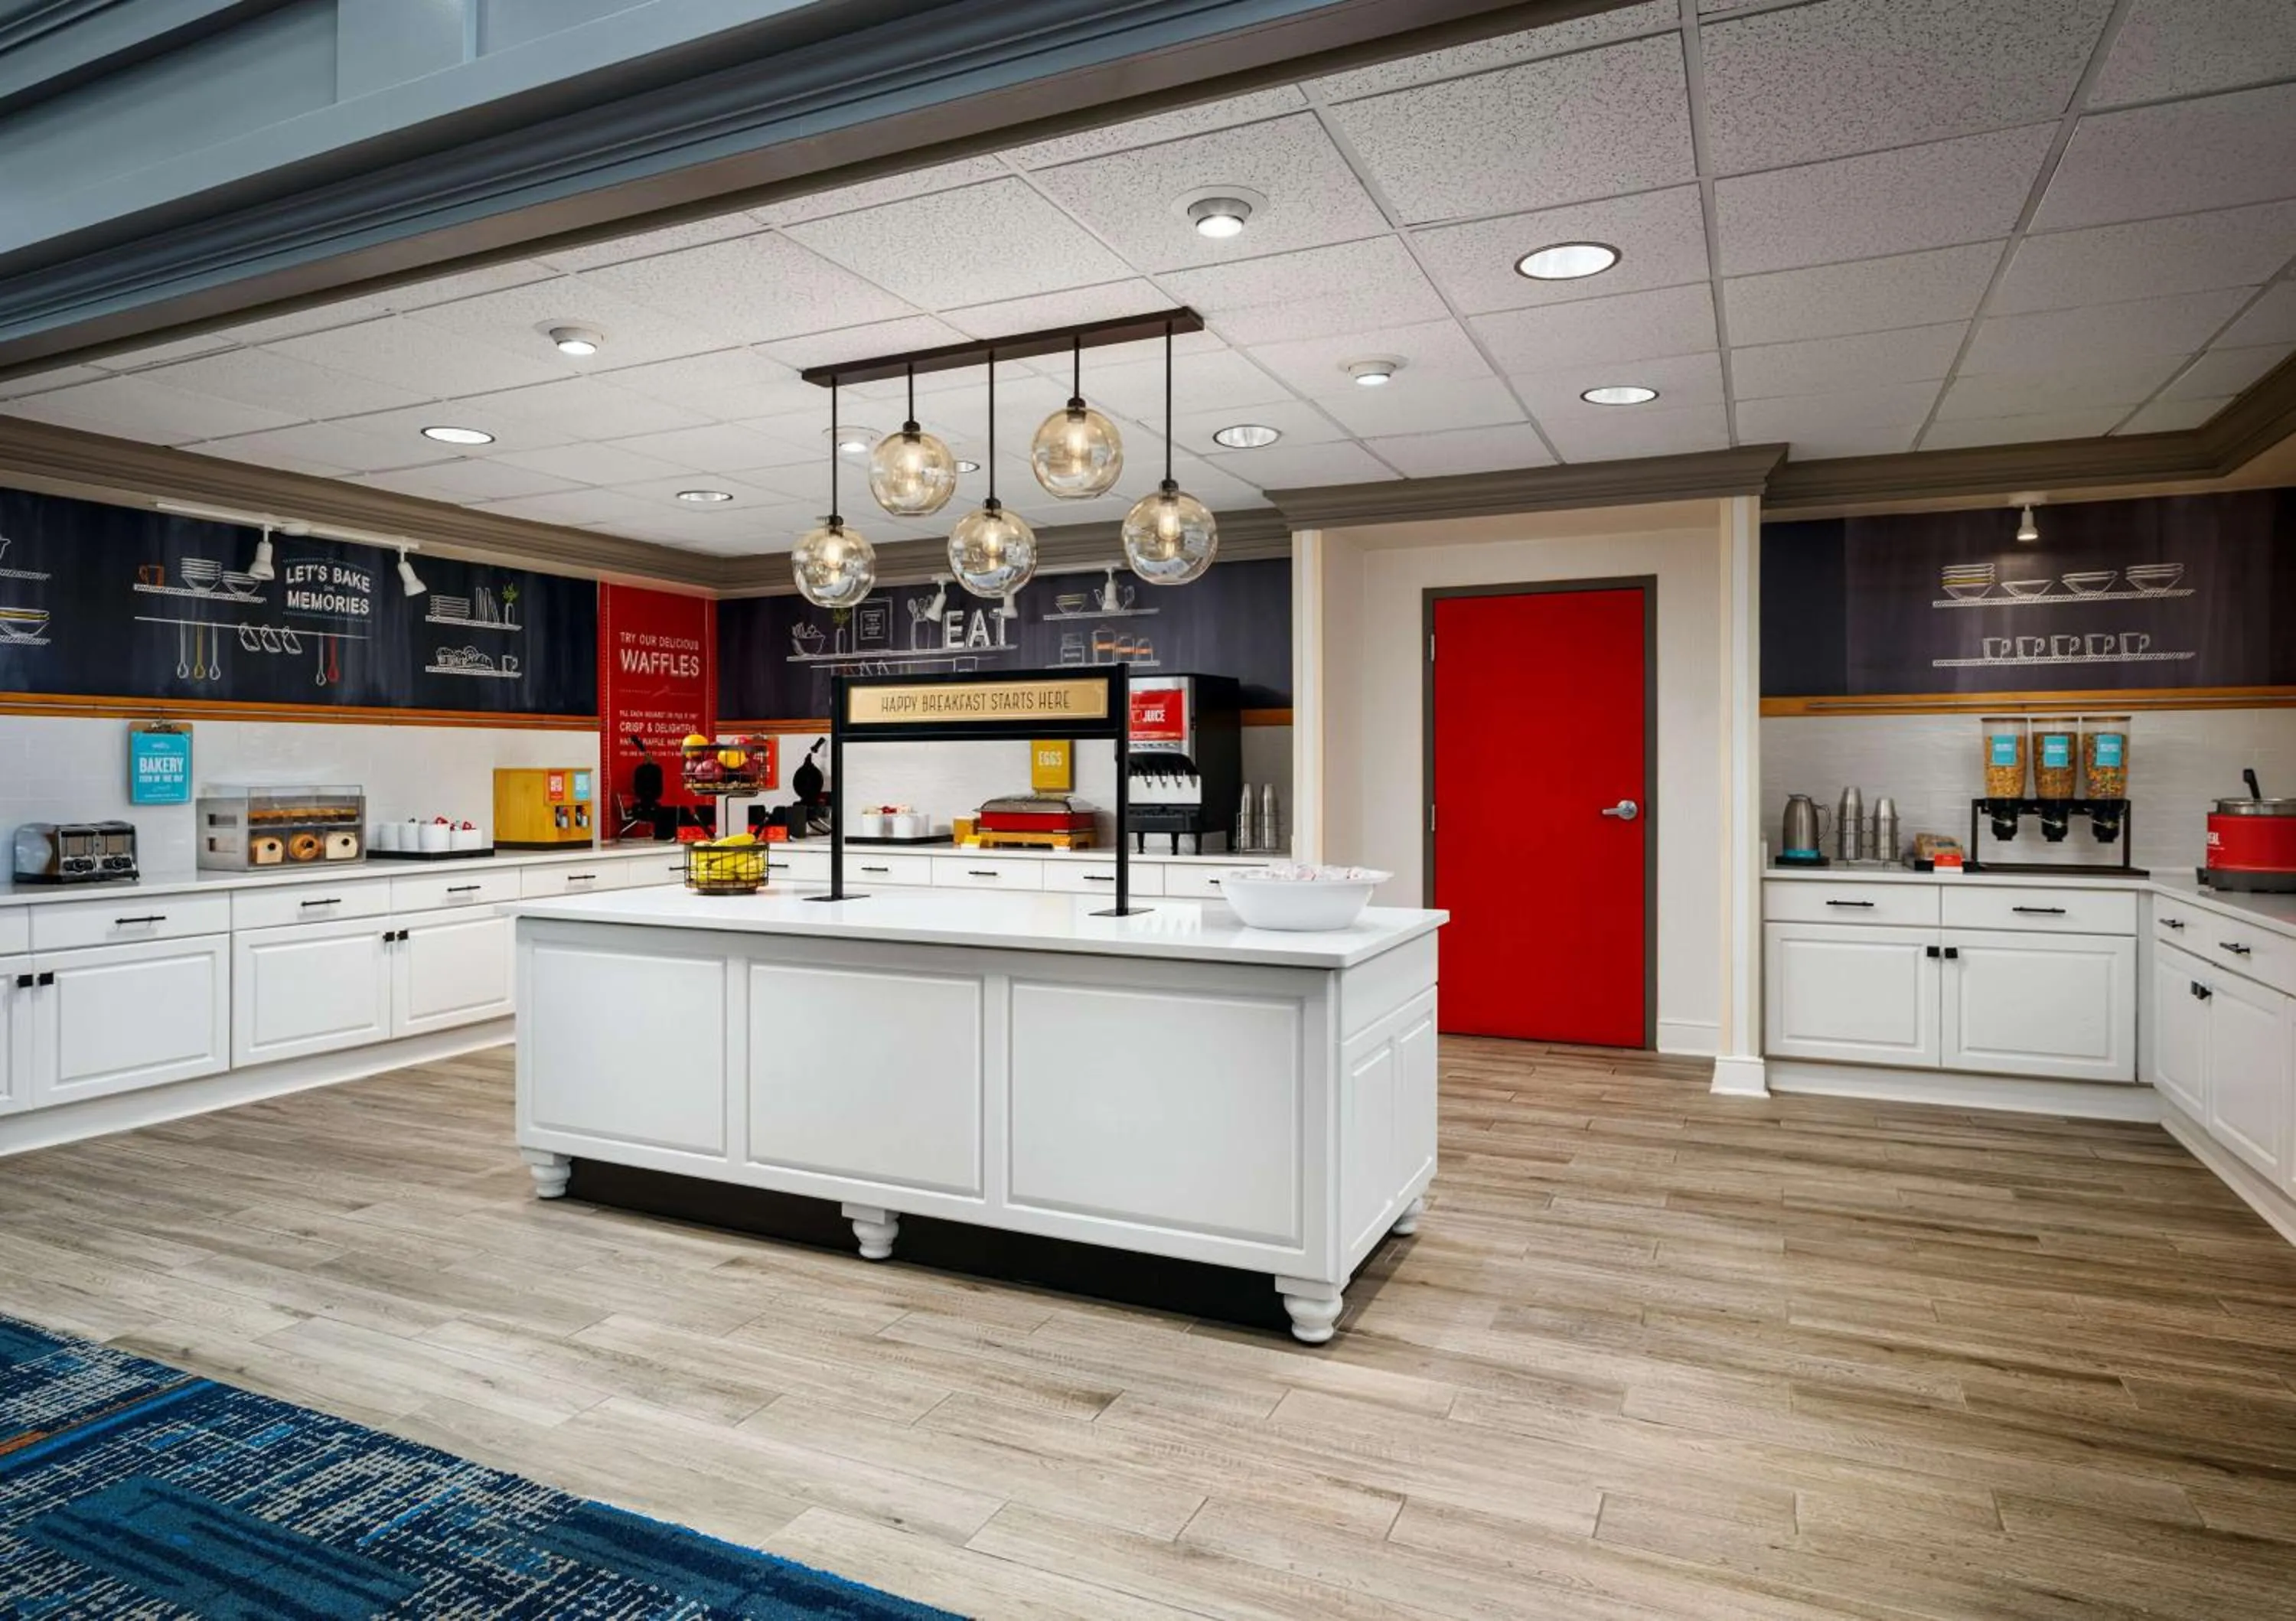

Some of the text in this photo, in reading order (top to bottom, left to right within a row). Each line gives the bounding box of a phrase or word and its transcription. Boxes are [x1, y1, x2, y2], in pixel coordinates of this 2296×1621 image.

[285, 565, 372, 593] LET'S BAKE
[287, 590, 370, 615] MEMORIES
[943, 608, 1006, 649] EAT
[620, 631, 700, 651] TRY OUR DELICIOUS
[620, 648, 700, 677] WAFFLES
[881, 690, 1071, 713] HAPPY BREAKFAST STARTS HERE
[1143, 709, 1166, 722] JUICE
[619, 721, 644, 733] CRISP
[139, 757, 184, 773] BAKERY
[1038, 750, 1063, 766] EGGS
